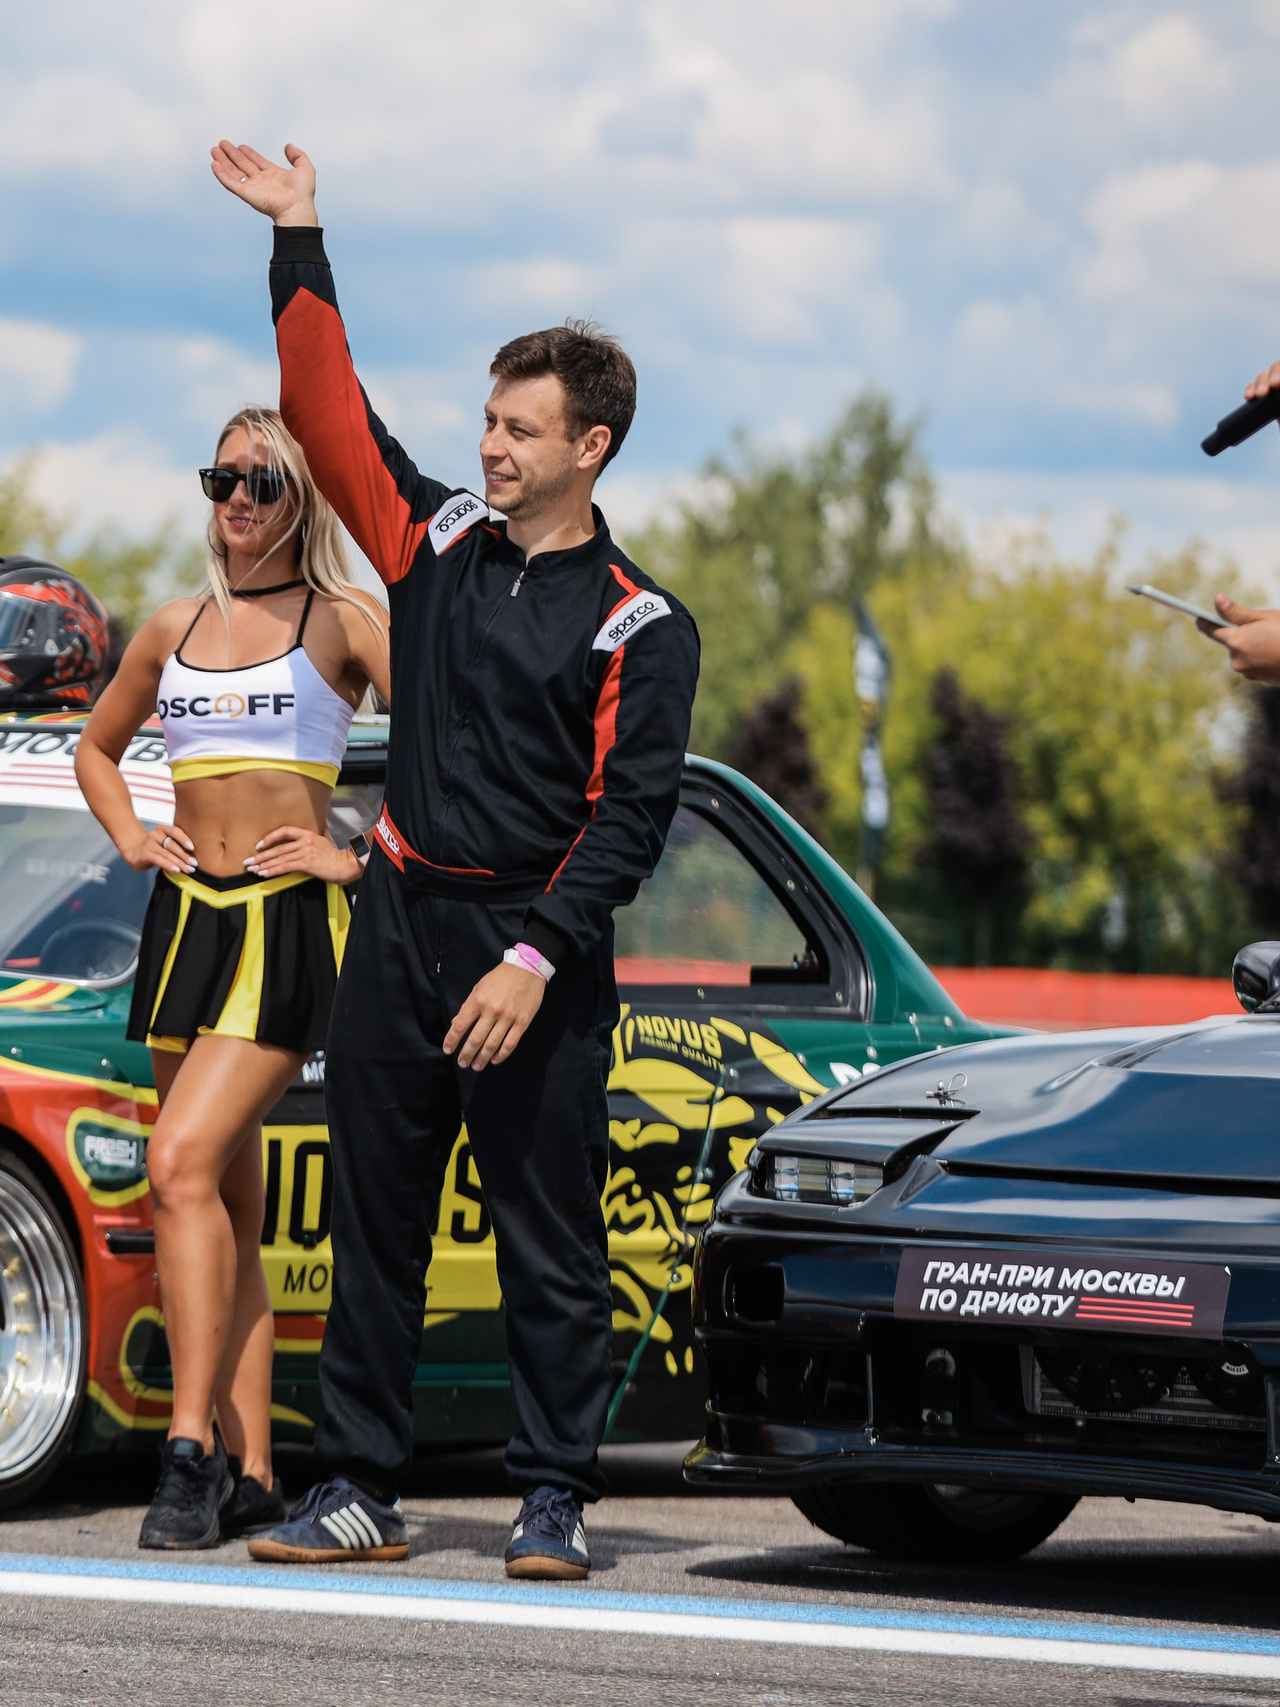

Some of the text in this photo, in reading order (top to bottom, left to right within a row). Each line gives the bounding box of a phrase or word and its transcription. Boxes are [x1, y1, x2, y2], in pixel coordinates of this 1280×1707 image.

[608, 601, 655, 640] sparco
[635, 1015, 723, 1060] NOVUS
[640, 1034, 679, 1055] PREMIUM
[923, 1261, 1186, 1298] ГРАН-ПРИ МОСКВЫ
[919, 1288, 1075, 1318] ПО ДРИФТУ
